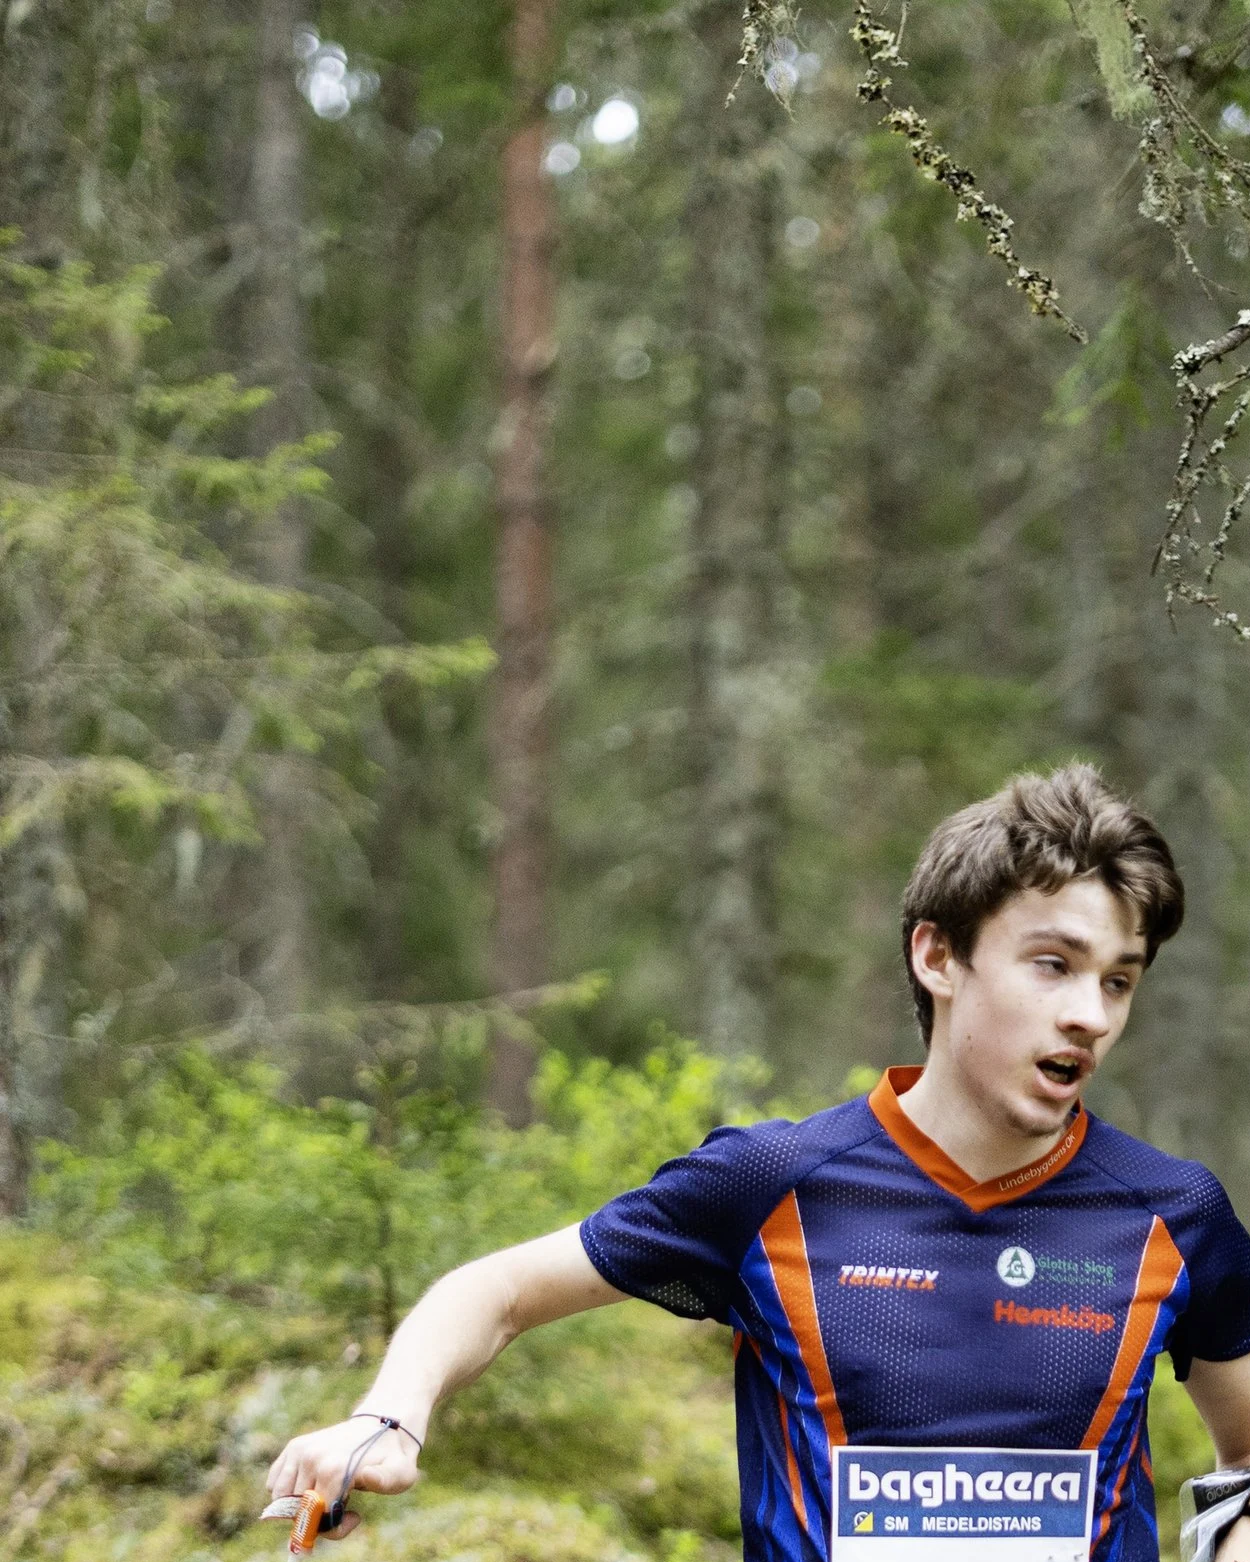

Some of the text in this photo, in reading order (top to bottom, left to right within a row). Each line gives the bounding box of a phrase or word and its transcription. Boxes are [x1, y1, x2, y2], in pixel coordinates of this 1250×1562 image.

[999, 1131, 1076, 1192] Lindebygdens OK
[839, 1265, 940, 1290] TRIMTEX
[994, 1299, 1115, 1334] Hemköp
[849, 1463, 1081, 1508] bagheera
[884, 1516, 1042, 1531] SM MEDELDISTANS
